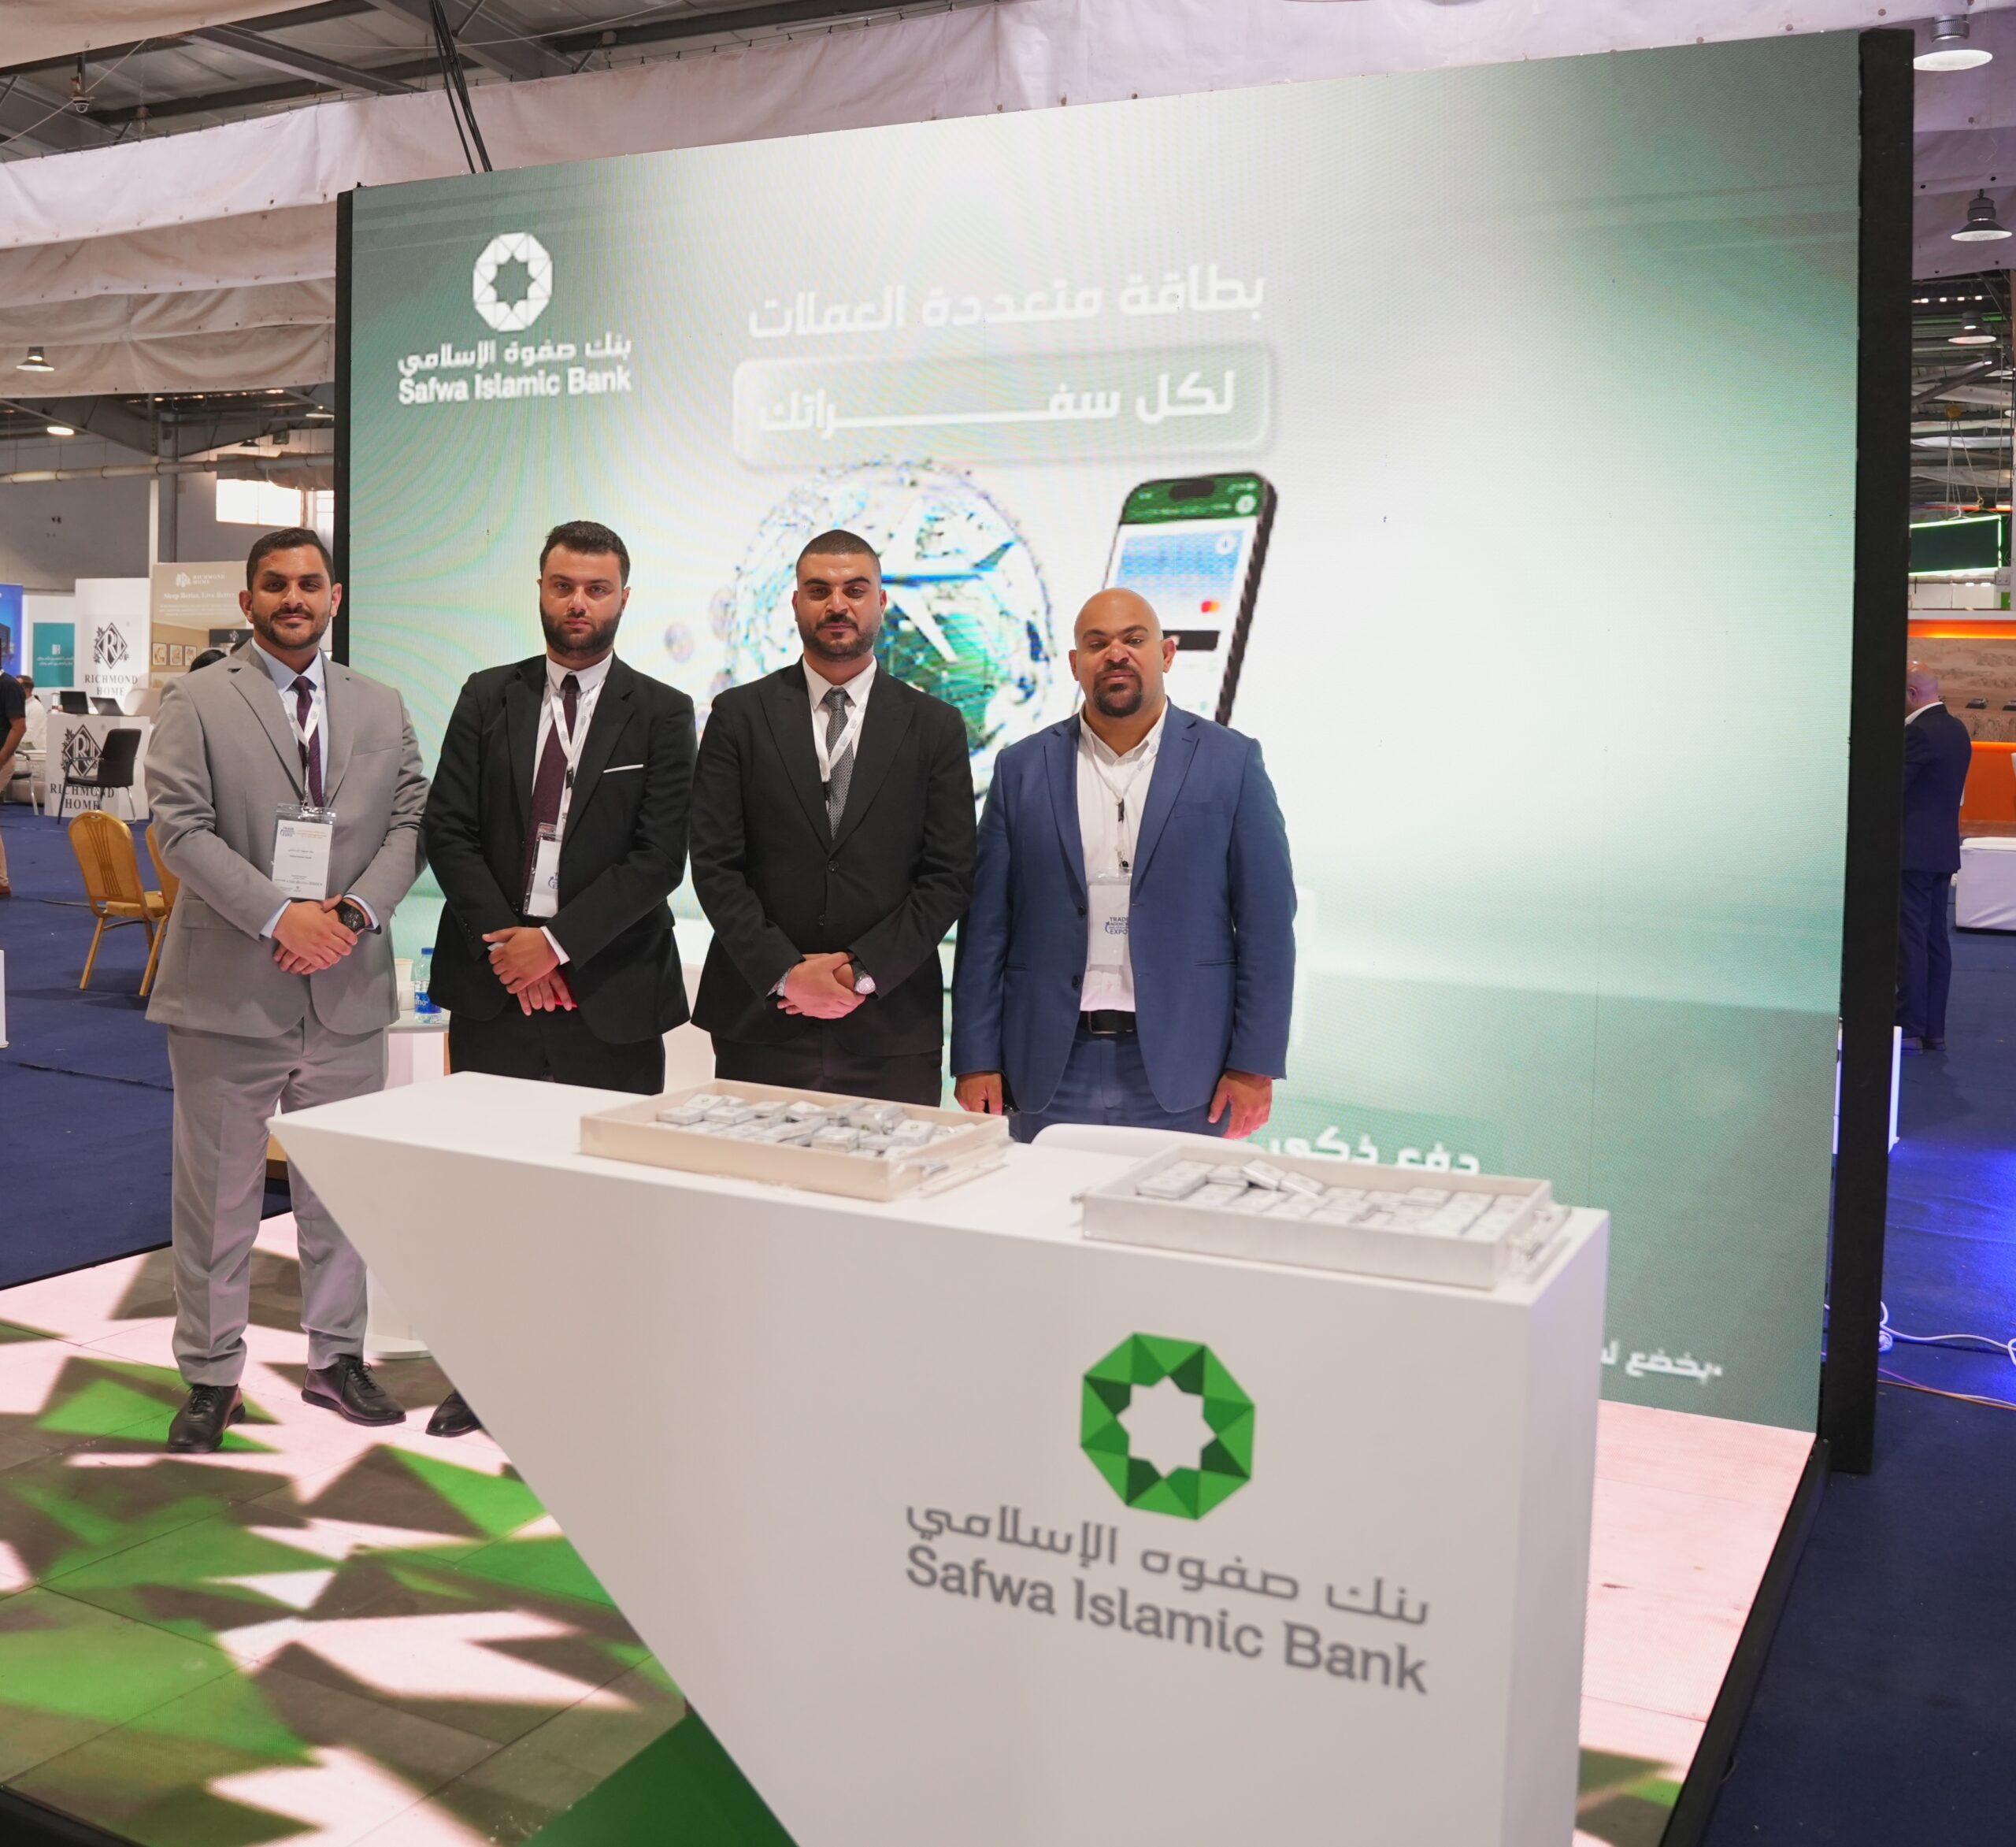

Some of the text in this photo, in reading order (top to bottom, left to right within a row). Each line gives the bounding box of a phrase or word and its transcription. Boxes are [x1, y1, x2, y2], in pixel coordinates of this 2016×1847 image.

[748, 265, 1265, 339] بطاقة متعددة العملات
[398, 330, 632, 377] بنك صفوة الإسلامي
[398, 365, 632, 405] Safwa Islamic Bank
[1136, 369, 1235, 425] لكل
[84, 673, 139, 684] RICHMOND
[97, 686, 125, 696] HOME
[906, 1503, 1118, 1569] الإسلامي
[906, 1543, 1429, 1696] Safwa Islamic Bank
